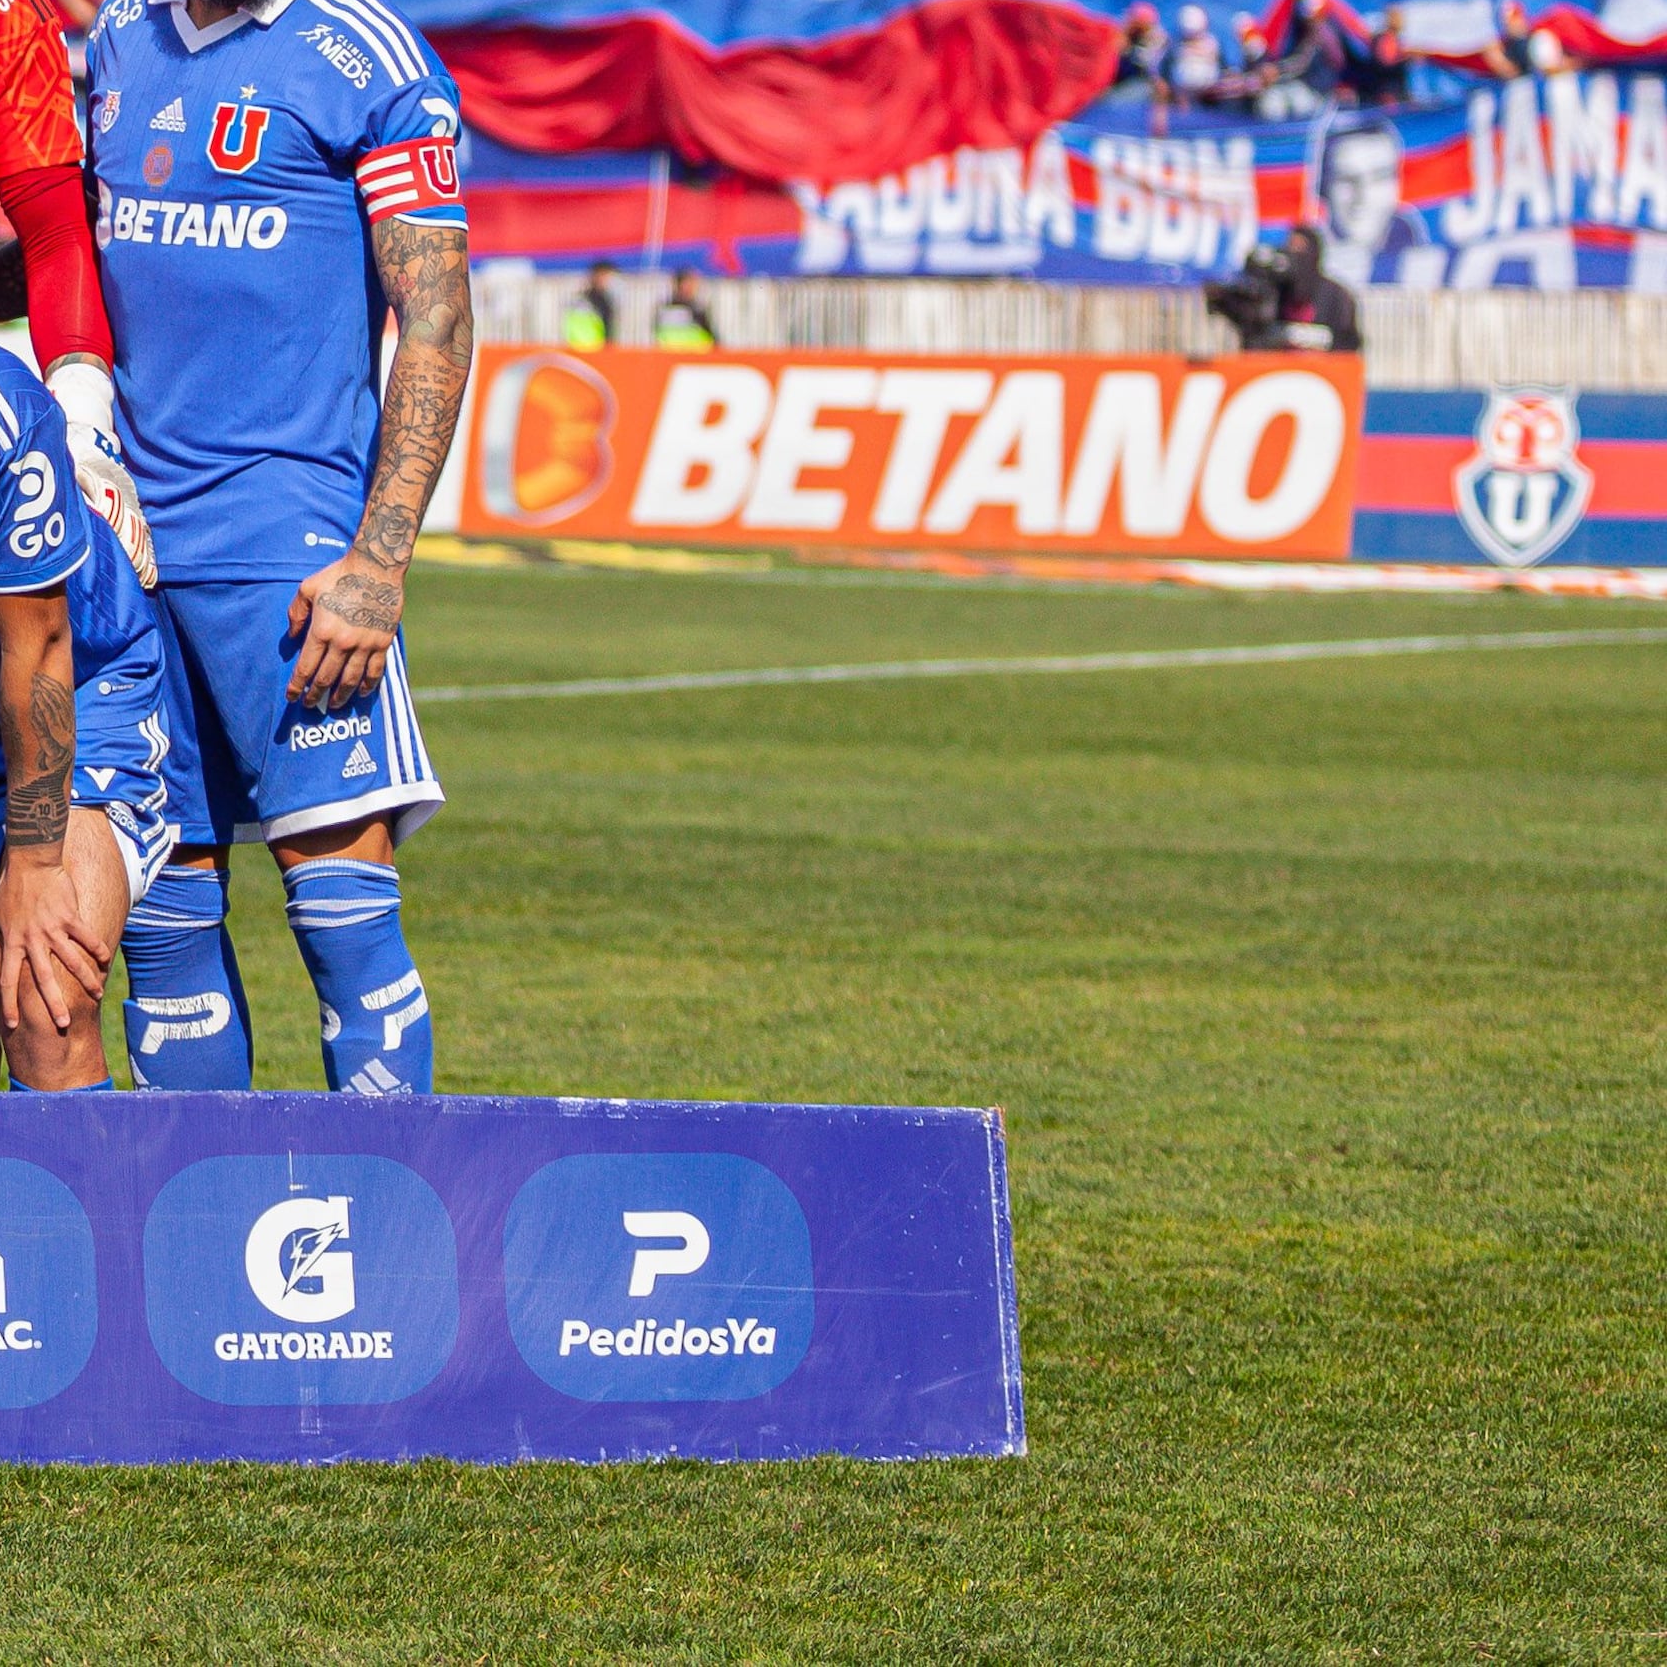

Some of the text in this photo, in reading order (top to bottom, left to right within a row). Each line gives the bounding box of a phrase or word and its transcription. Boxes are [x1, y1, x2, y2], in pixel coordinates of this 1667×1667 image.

[115, 3, 143, 29] GO
[317, 37, 373, 90] MEDS
[337, 33, 373, 71] CLINICA
[206, 101, 270, 174] U
[419, 144, 461, 199] U
[114, 197, 288, 250] BETANO
[630, 363, 1351, 544] BETANO
[1484, 468, 1561, 534] U
[9, 514, 66, 558] GO
[290, 713, 372, 752] Rexona
[342, 762, 378, 780] adidas
[214, 1331, 393, 1361] GATORADE
[558, 1317, 777, 1359] PedidosYa
